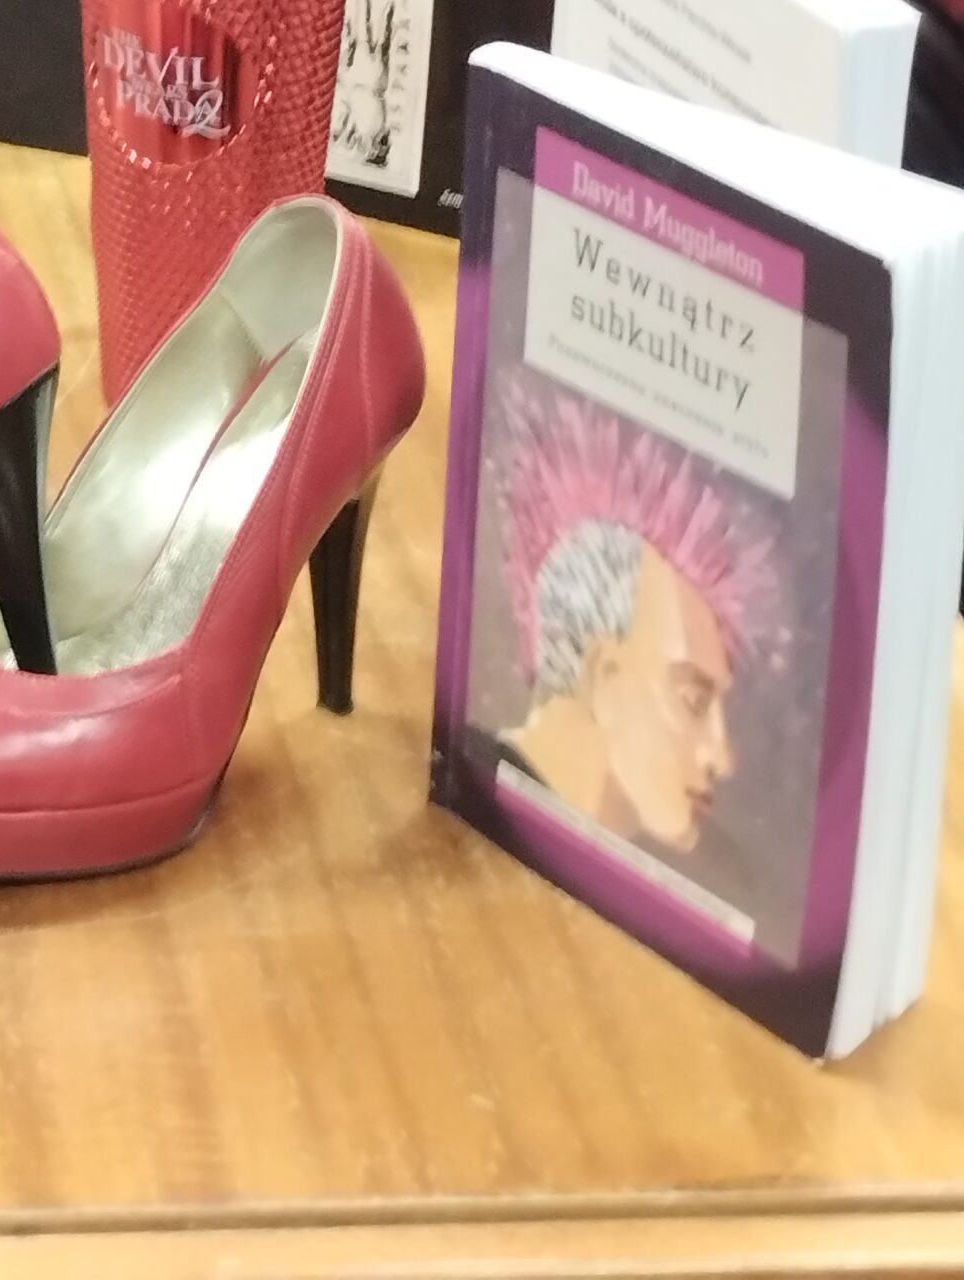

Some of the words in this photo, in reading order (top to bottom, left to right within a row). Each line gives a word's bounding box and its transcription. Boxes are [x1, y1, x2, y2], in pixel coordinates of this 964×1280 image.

[101, 46, 220, 90] DEVIL
[572, 160, 635, 219] David
[644, 196, 764, 287] Muggleton
[572, 226, 755, 353] Wewnątrz
[570, 294, 751, 412] subkultury
